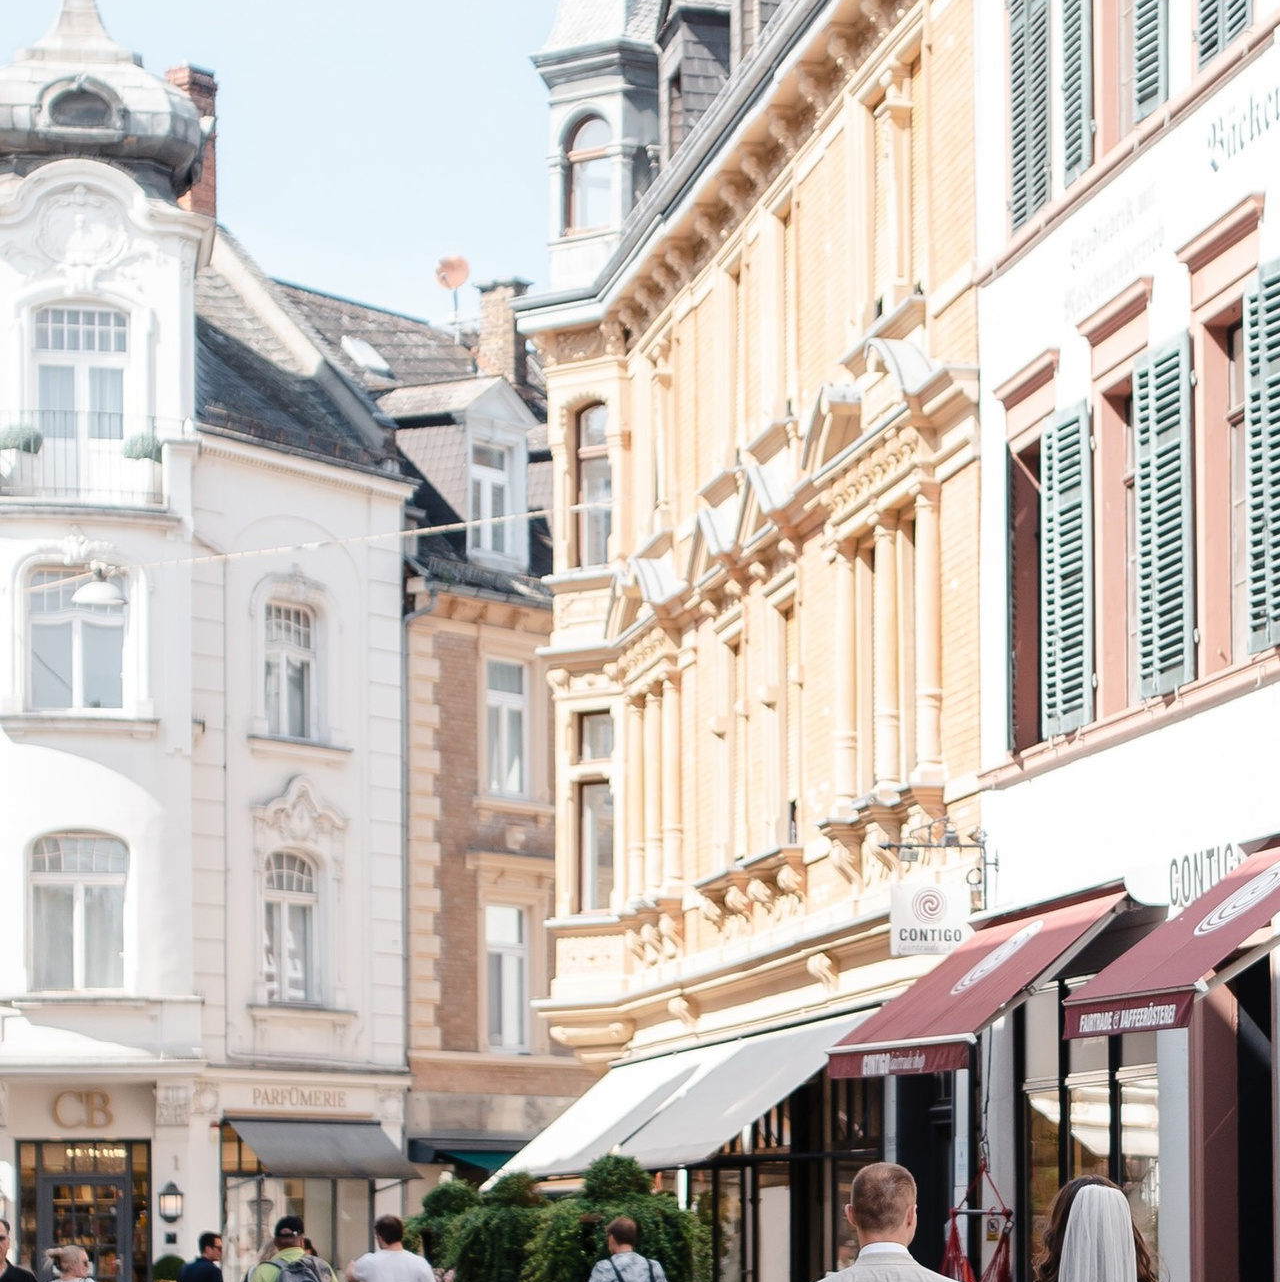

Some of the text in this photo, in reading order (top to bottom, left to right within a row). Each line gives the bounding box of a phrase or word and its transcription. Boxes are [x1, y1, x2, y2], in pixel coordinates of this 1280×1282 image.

[1169, 842, 1242, 906] CONTIG
[899, 927, 963, 942] CONTIGO
[51, 1089, 114, 1129] CB
[252, 1085, 347, 1108] PARFÜMERIE
